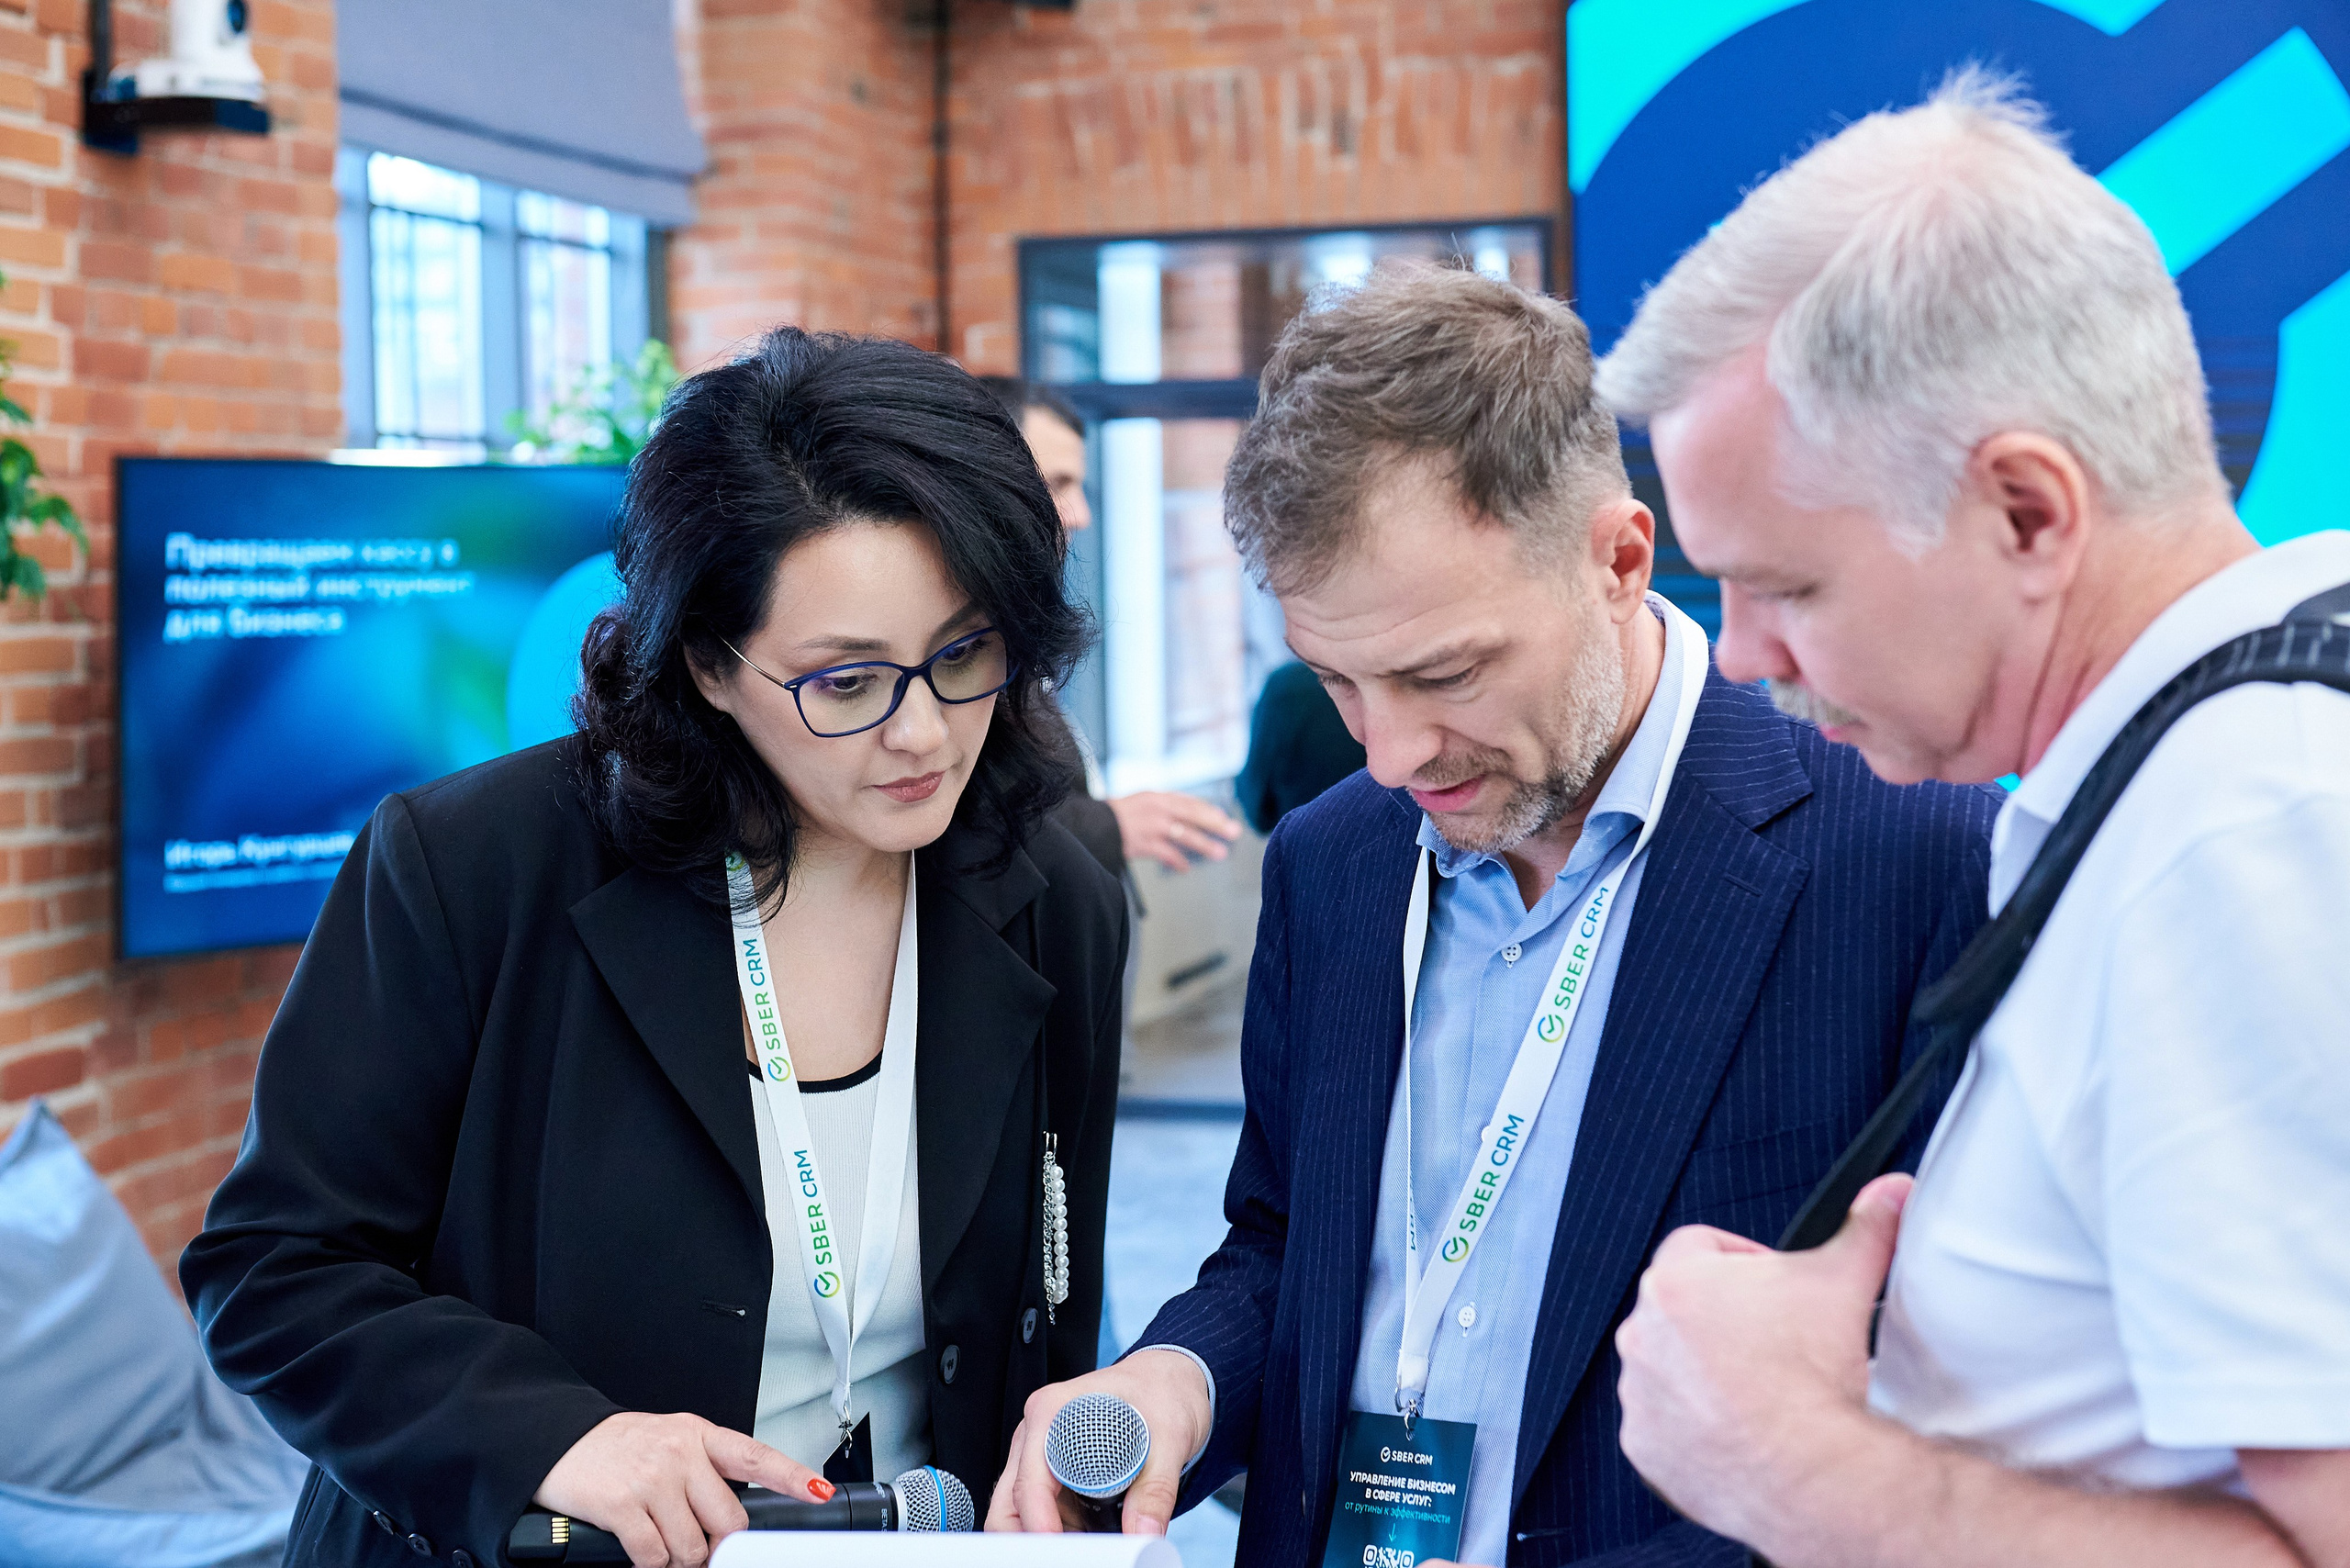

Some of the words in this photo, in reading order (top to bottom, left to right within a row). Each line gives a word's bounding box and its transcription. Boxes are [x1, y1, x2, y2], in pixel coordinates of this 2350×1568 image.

[743, 938, 766, 986] CRM
[1554, 944, 1590, 1010] SBER
[1581, 887, 1609, 938] CRM
[755, 991, 781, 1050] SBER
[793, 1149, 818, 1197] CRM
[1460, 1170, 1501, 1232] SBER
[1491, 1114, 1525, 1166] CRM
[807, 1203, 833, 1265] SBER
[1392, 1450, 1414, 1463] SBER
[1415, 1452, 1433, 1465] CRM
[1349, 1471, 1406, 1488] УПРАВЛЕНИЕ
[1407, 1478, 1456, 1495] БИЗНЕСОМ
[1365, 1488, 1371, 1499] В
[1372, 1489, 1401, 1503] СФЕРЕ
[1402, 1493, 1432, 1507] УСЛУГ:
[1344, 1501, 1353, 1510] от
[1355, 1503, 1383, 1514] рутины
[1383, 1506, 1389, 1516] к
[1390, 1506, 1450, 1524] эффективности
